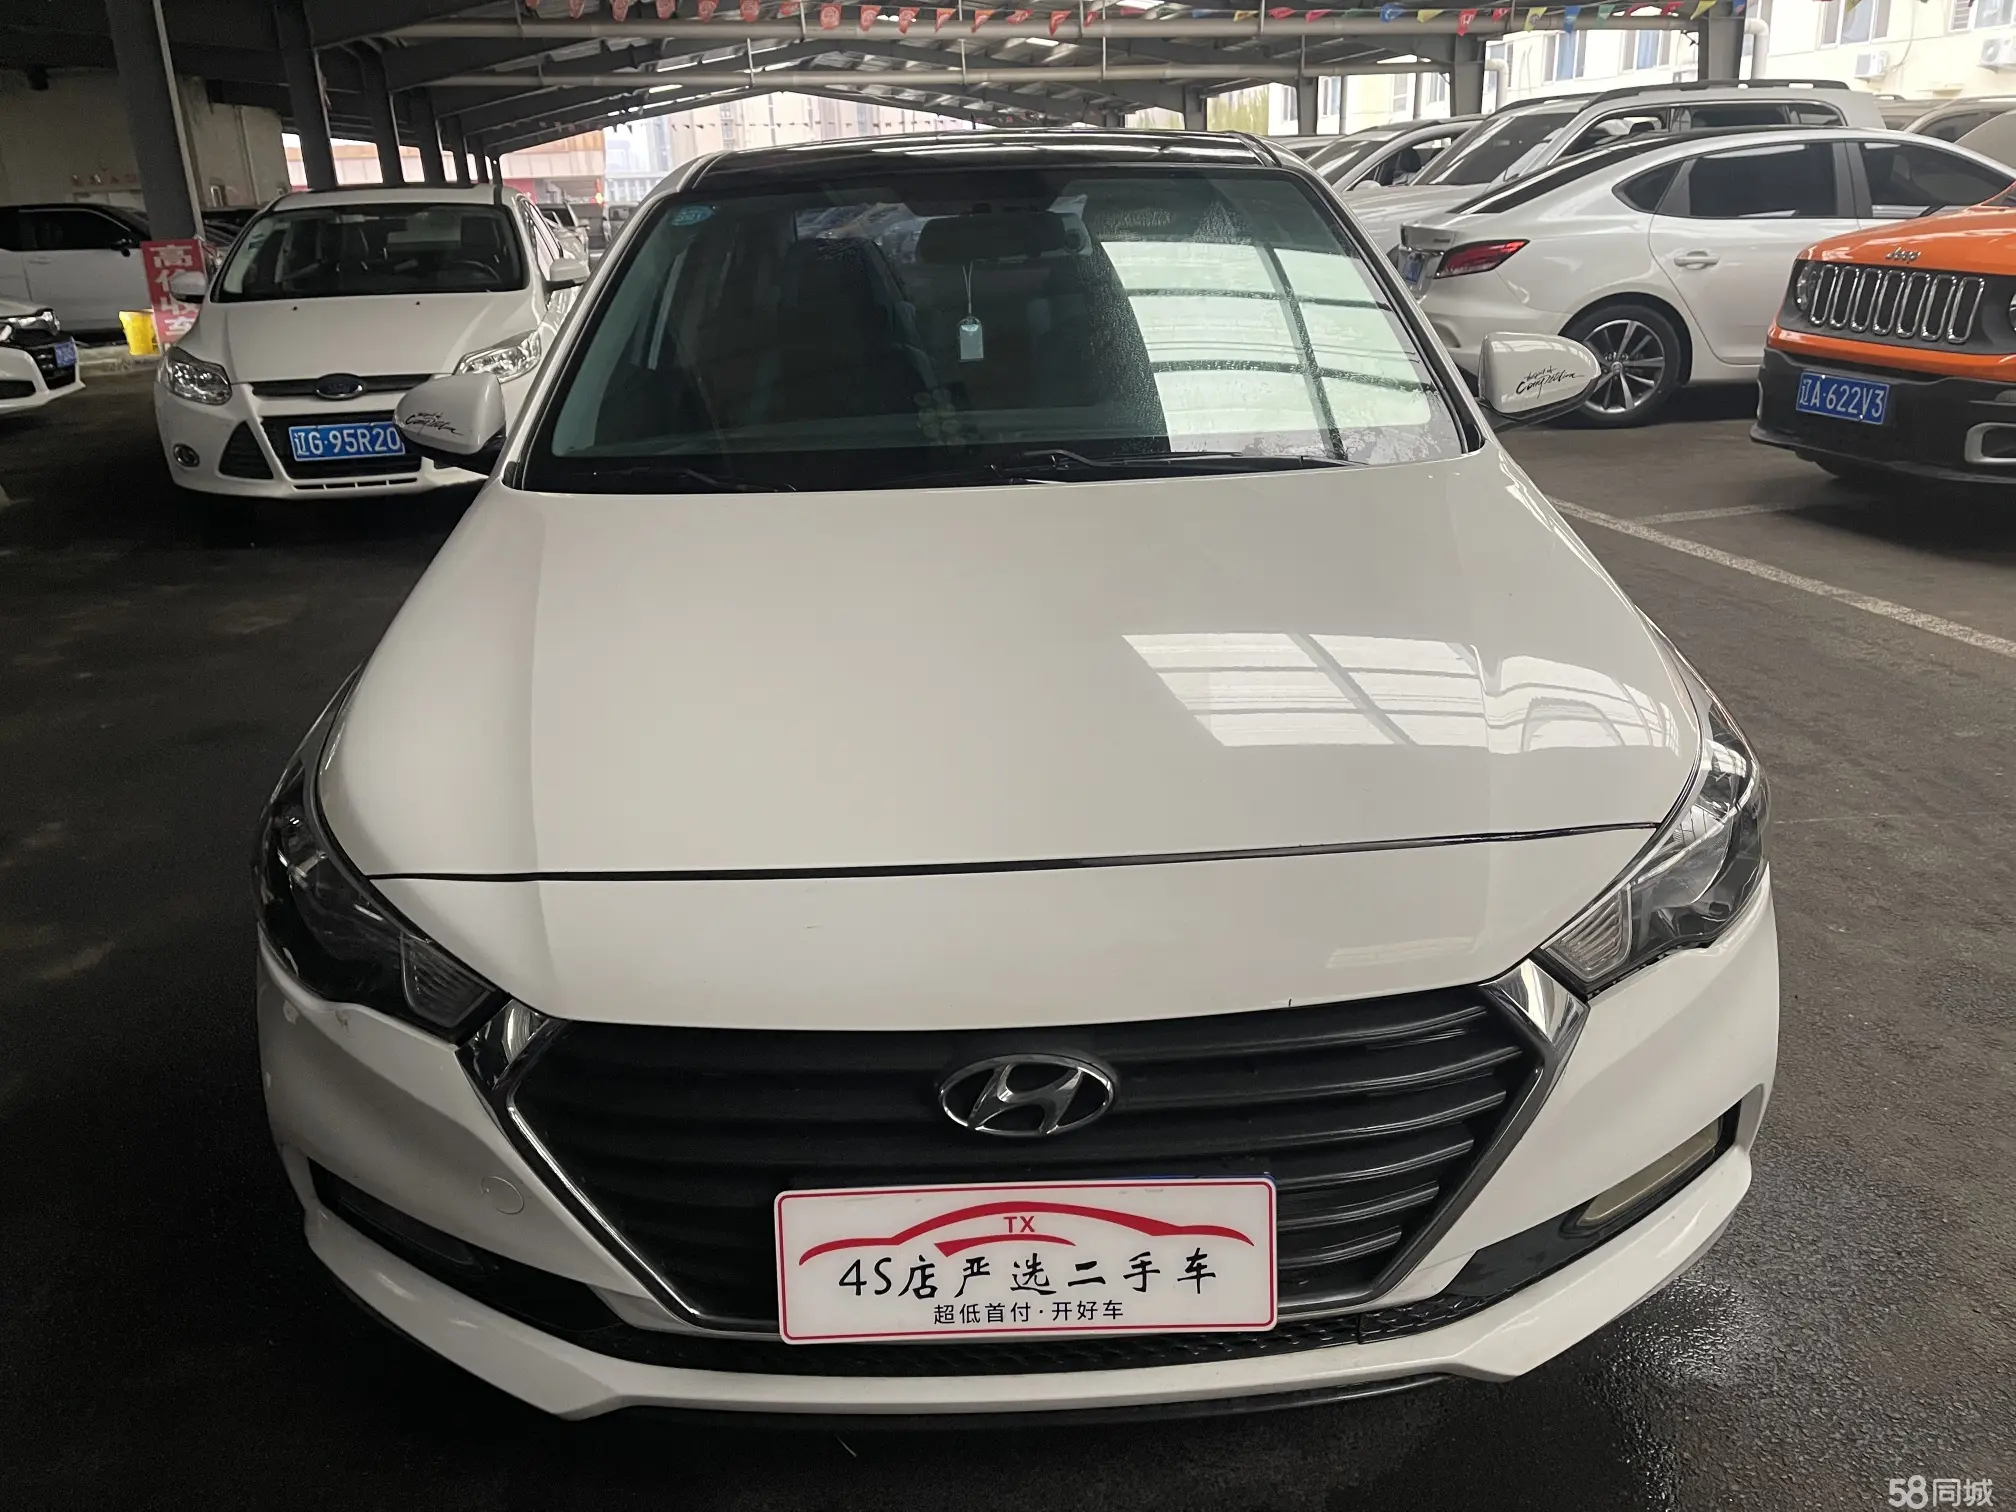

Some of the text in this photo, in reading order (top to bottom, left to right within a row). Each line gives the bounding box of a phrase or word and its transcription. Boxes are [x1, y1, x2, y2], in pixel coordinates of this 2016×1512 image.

[1003, 1215, 1035, 1233] TX
[838, 1248, 1217, 1299] 4S店严选二手车
